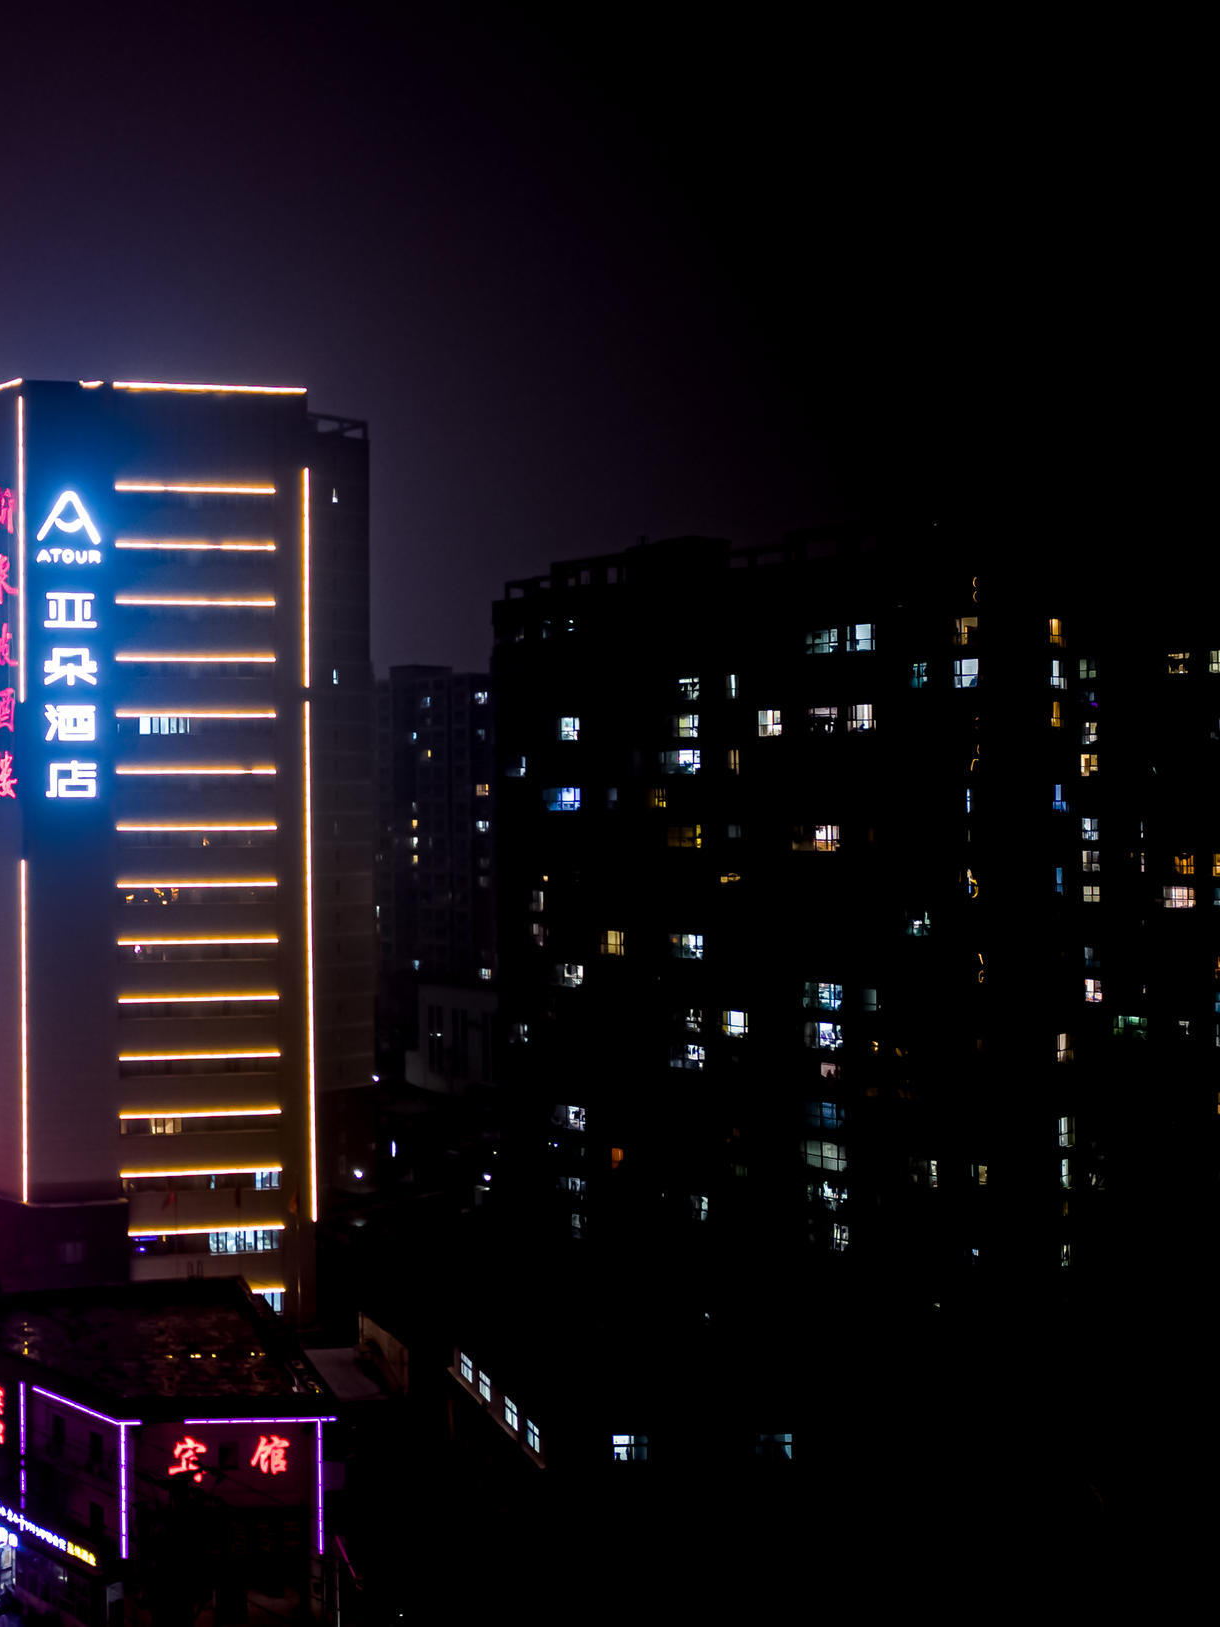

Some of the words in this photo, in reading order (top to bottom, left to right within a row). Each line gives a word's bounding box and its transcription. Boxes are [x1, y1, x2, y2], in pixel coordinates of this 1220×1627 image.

[36, 548, 101, 565] ATOUR
[43, 591, 98, 799] 亚朵酒店
[168, 1435, 290, 1483] 宾馆
